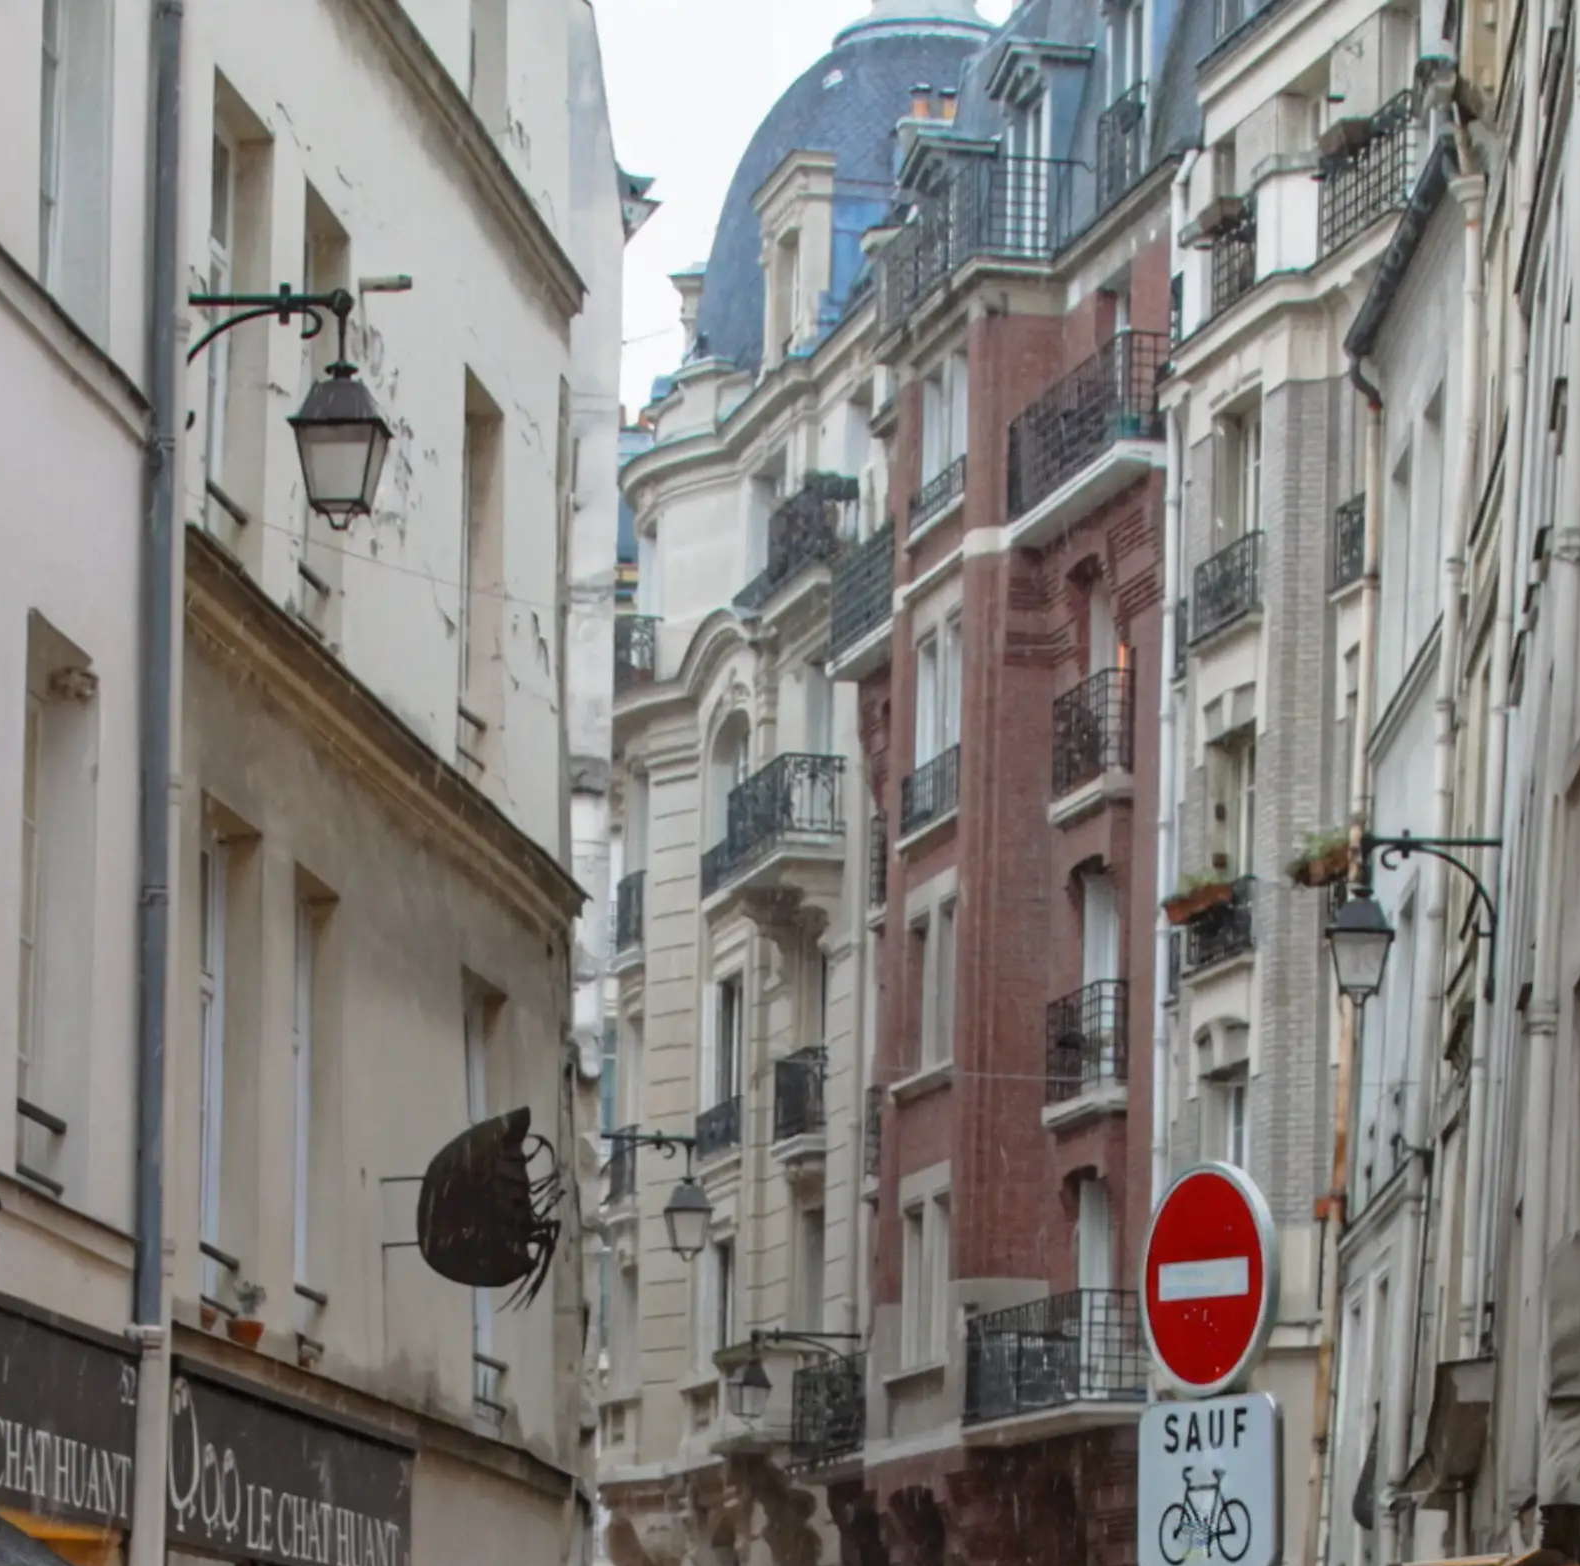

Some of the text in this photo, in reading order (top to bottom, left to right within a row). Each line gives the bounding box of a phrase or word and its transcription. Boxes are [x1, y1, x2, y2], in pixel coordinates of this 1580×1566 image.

[1163, 1406, 1249, 1455] SAUF
[53, 1435, 133, 1519] HUANT
[245, 1484, 274, 1552] LE
[278, 1492, 333, 1565] CHAT
